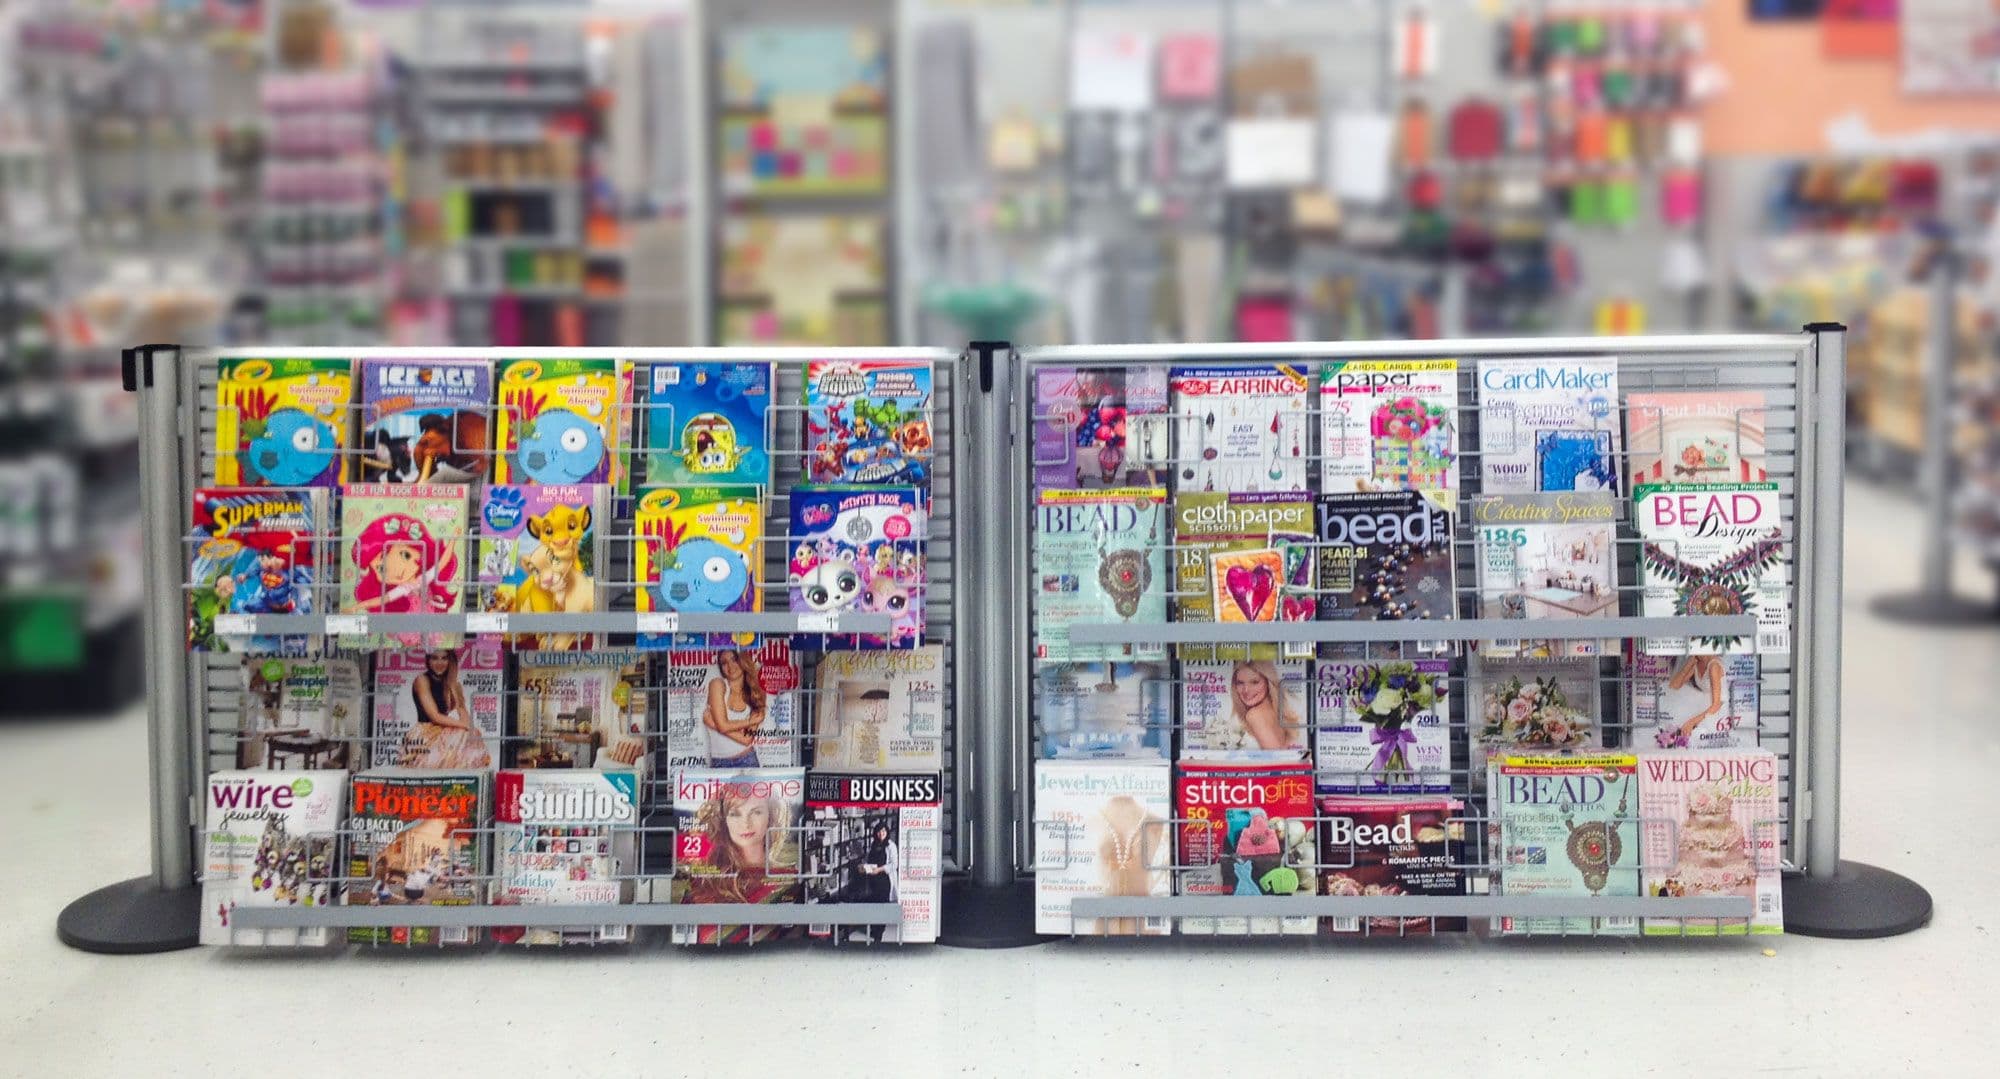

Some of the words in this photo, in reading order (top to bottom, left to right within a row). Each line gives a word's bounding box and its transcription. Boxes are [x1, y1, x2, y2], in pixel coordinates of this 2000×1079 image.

[430, 366, 476, 388] AGE
[1338, 372, 1418, 398] paper
[1484, 367, 1614, 393] CardMaker
[558, 385, 608, 398] Swimming
[1207, 379, 1306, 395] EARRINGS
[1233, 424, 1254, 432] EASY
[543, 486, 558, 496] BIG
[560, 486, 578, 496] FUN
[1707, 485, 1739, 494] Beading
[1741, 484, 1773, 493] Projects
[1182, 500, 1236, 525] cloth
[1240, 508, 1304, 531] paper
[1482, 500, 1553, 522] Creative
[1556, 495, 1614, 523] Spaces
[1655, 494, 1762, 526] BEAD
[213, 501, 304, 538] SUPERMAN
[697, 513, 751, 526] Swimming
[1044, 505, 1137, 534] BEAD
[1189, 523, 1240, 531] scissors
[1318, 499, 1432, 544] bead
[708, 523, 741, 535] Along!
[1484, 528, 1527, 547] 186
[1685, 513, 1758, 545] Design
[1182, 549, 1202, 566] 18
[1322, 596, 1337, 608] 63
[670, 668, 707, 683] Strong
[679, 679, 704, 690] Sexy
[909, 680, 937, 692] 125+
[1716, 716, 1741, 732] 637
[671, 757, 687, 767] Eat
[1646, 759, 1774, 783] WEDDING
[679, 769, 801, 801] knitscene
[810, 779, 840, 790] WHERE
[850, 778, 935, 801] BUSINESS
[1185, 778, 1265, 805] stitch
[1264, 778, 1309, 804] gifts
[1506, 775, 1605, 804] BEAD
[212, 779, 295, 808] wire
[354, 783, 477, 816] Pioneer
[810, 789, 840, 800] WOMEN
[518, 787, 630, 821] studios
[220, 804, 290, 831] jewelry
[352, 818, 365, 831] GO
[367, 818, 389, 831] BACK
[391, 818, 404, 831] TO
[1331, 814, 1415, 847] Bead
[509, 830, 537, 853] 27
[683, 836, 702, 854] 23
[1389, 844, 1416, 852] trends
[1388, 856, 1428, 865] ROMANTIC
[508, 874, 558, 889] holiday
[508, 888, 529, 896] WISH
[575, 891, 616, 901] STUDIO
